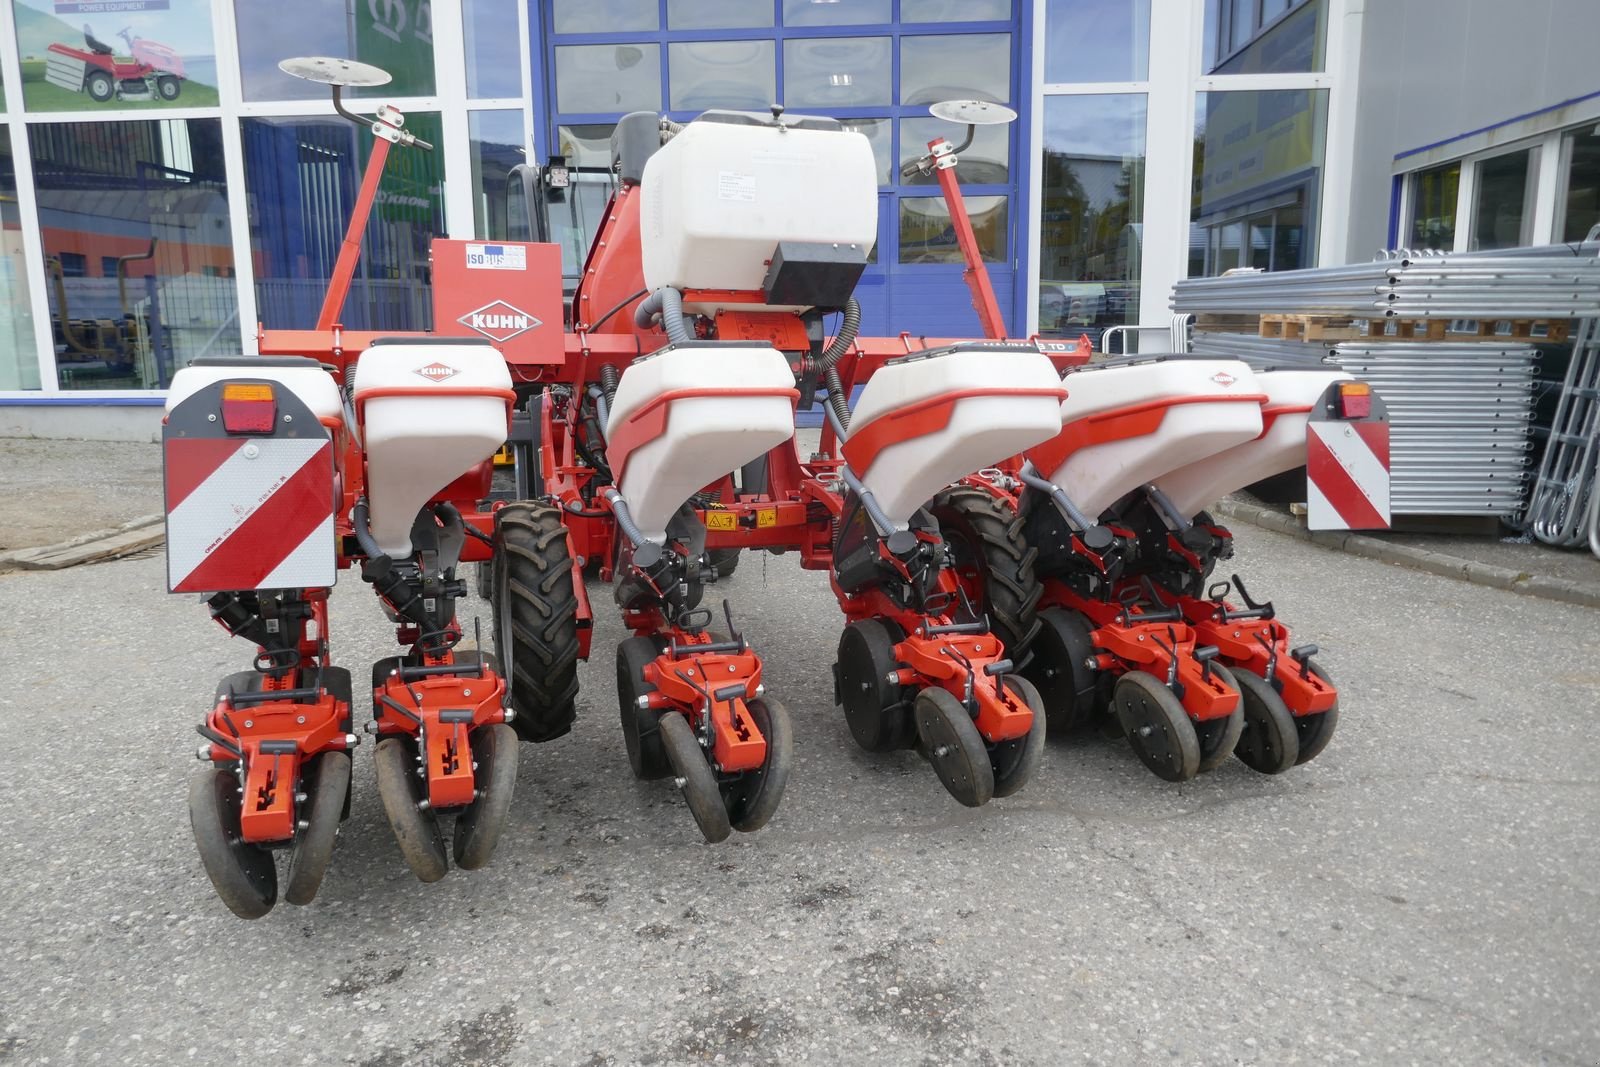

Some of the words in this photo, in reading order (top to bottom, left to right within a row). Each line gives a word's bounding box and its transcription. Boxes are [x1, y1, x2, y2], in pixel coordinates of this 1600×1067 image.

[79, 4, 103, 12] POWER
[106, 2, 145, 11] EQUIPMENT
[472, 314, 528, 329] KUHN
[421, 367, 453, 375] KUHN
